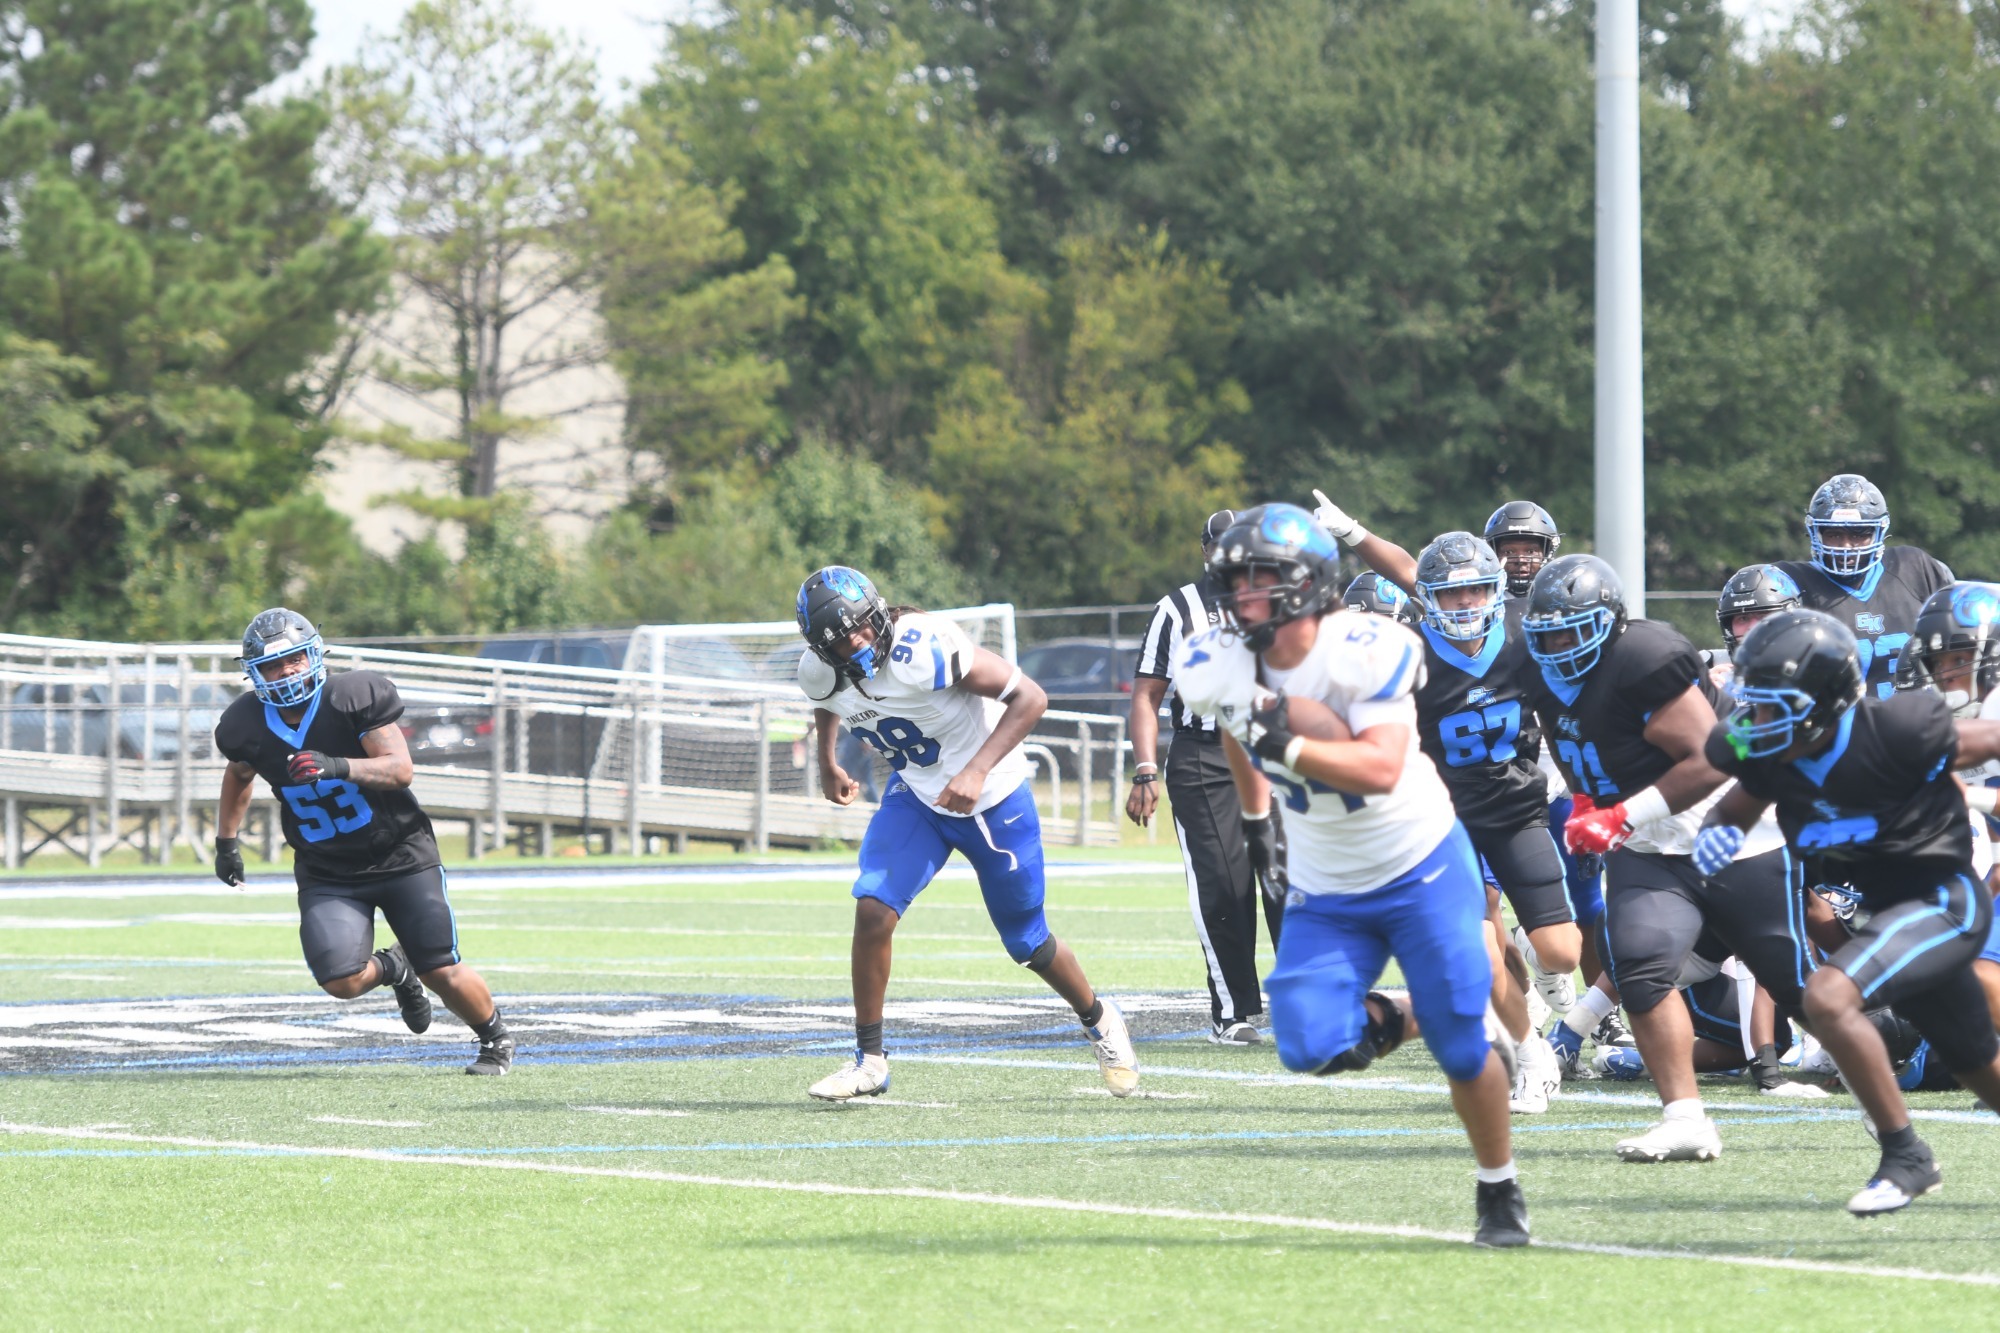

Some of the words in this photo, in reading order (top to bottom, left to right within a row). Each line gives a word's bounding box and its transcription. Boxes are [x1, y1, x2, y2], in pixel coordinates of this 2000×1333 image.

[891, 628, 922, 664] 98
[850, 717, 941, 771] 98
[1439, 700, 1520, 767] 67
[1555, 740, 1620, 796] 71
[281, 779, 373, 843] 53
